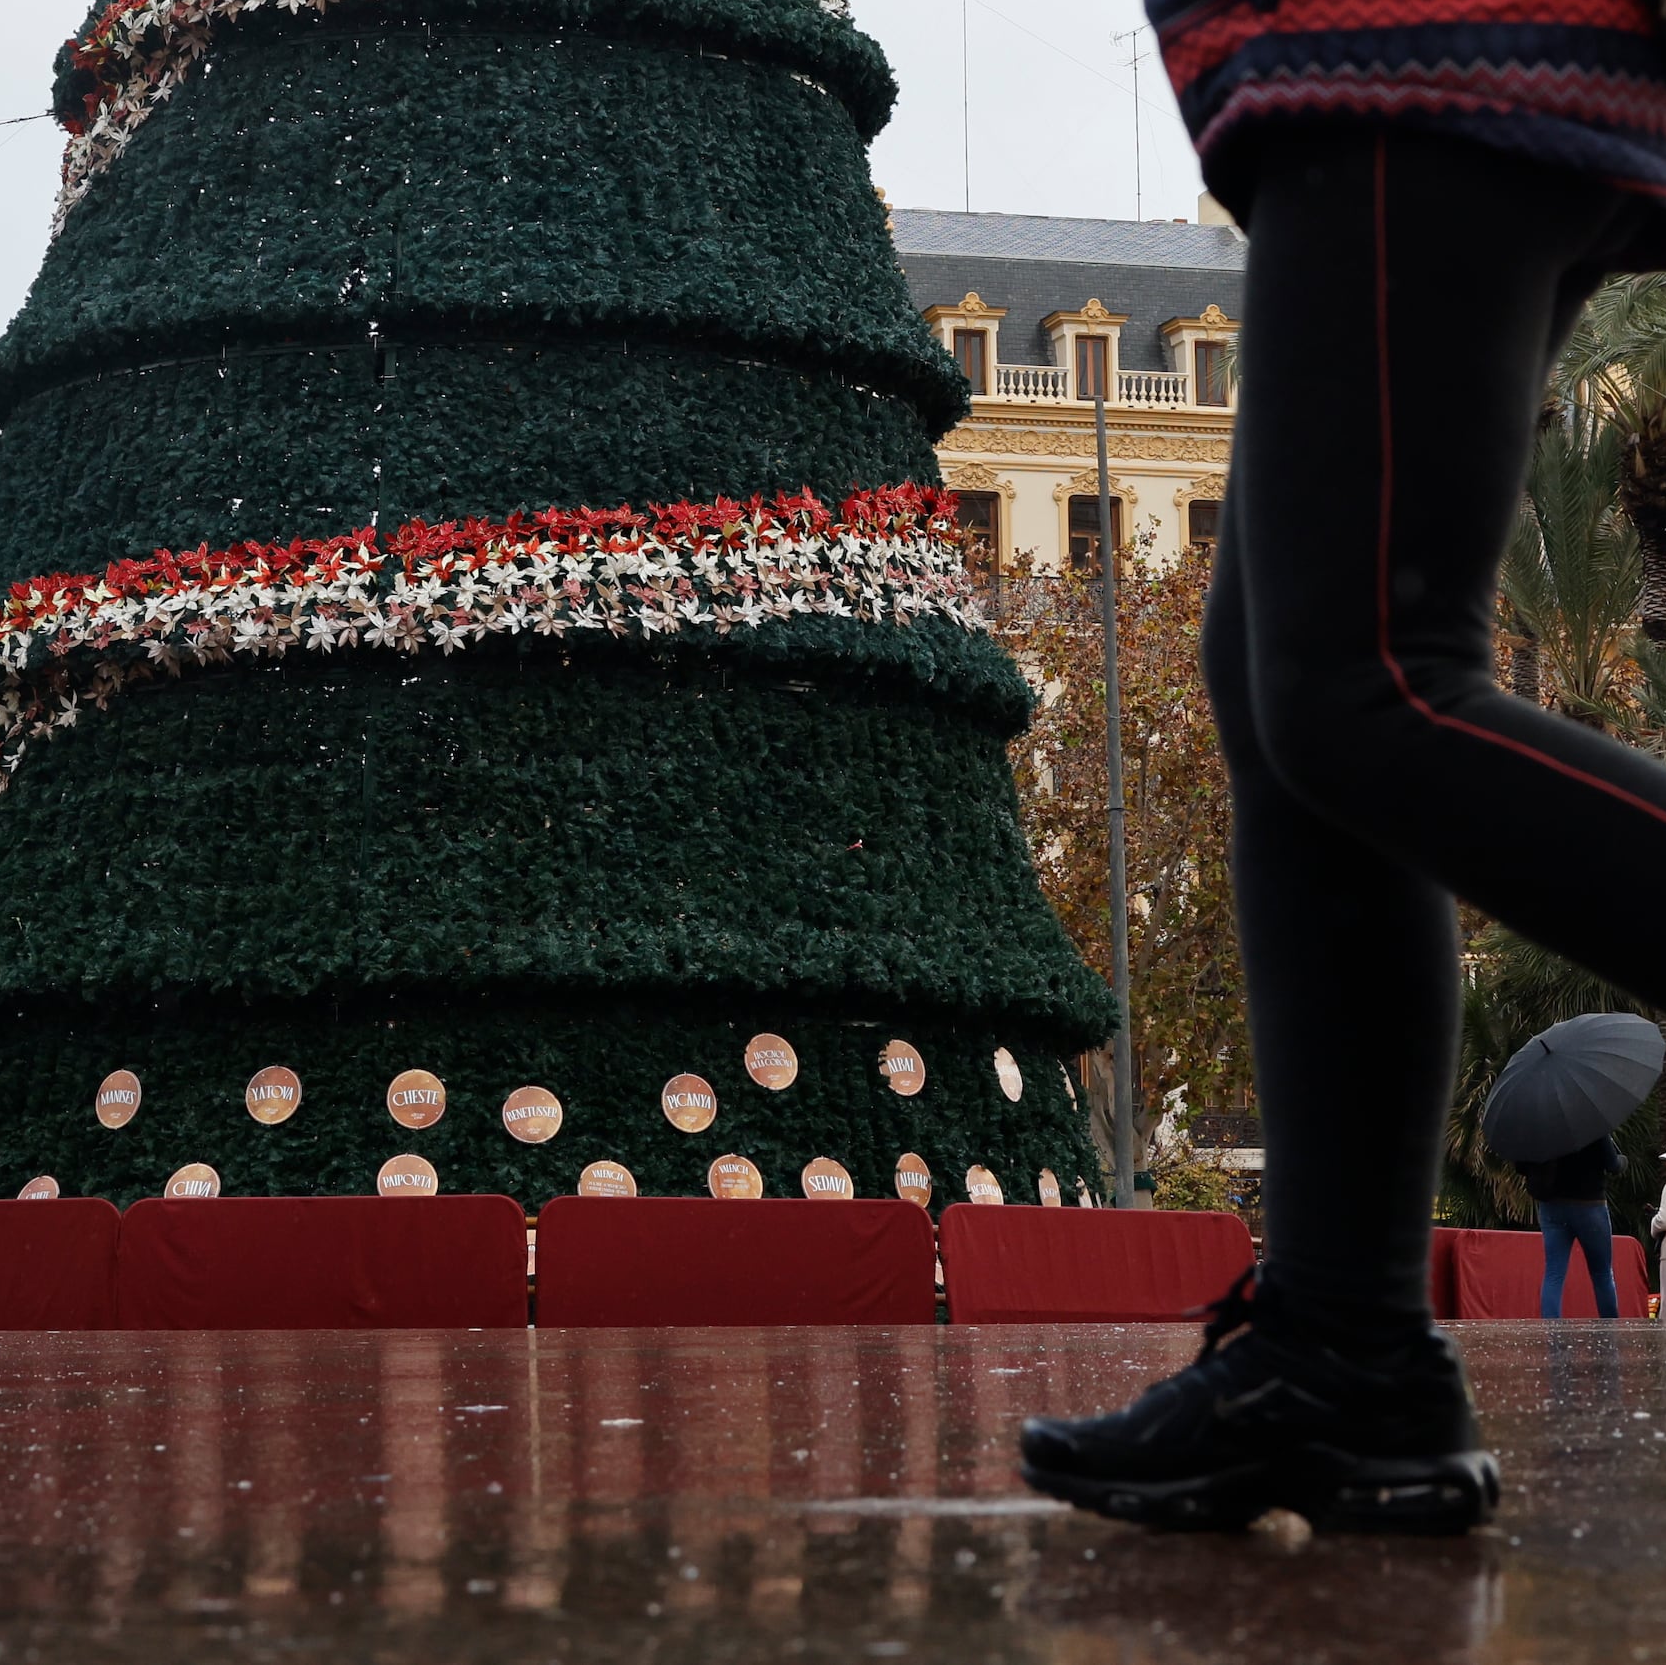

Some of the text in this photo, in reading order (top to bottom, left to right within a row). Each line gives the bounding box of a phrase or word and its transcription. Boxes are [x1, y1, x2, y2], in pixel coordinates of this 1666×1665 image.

[100, 1089, 136, 1106] MANISES
[251, 1085, 294, 1102] YATOVA
[392, 1089, 440, 1106] CHESTE
[666, 1092, 712, 1110] PICANYA
[592, 1169, 625, 1183] VALENCIA
[718, 1163, 750, 1177] VALENCIA
[172, 1180, 213, 1197] CHIVA
[382, 1173, 432, 1189] PAIPORTA
[899, 1171, 929, 1191] ALFAFAR
